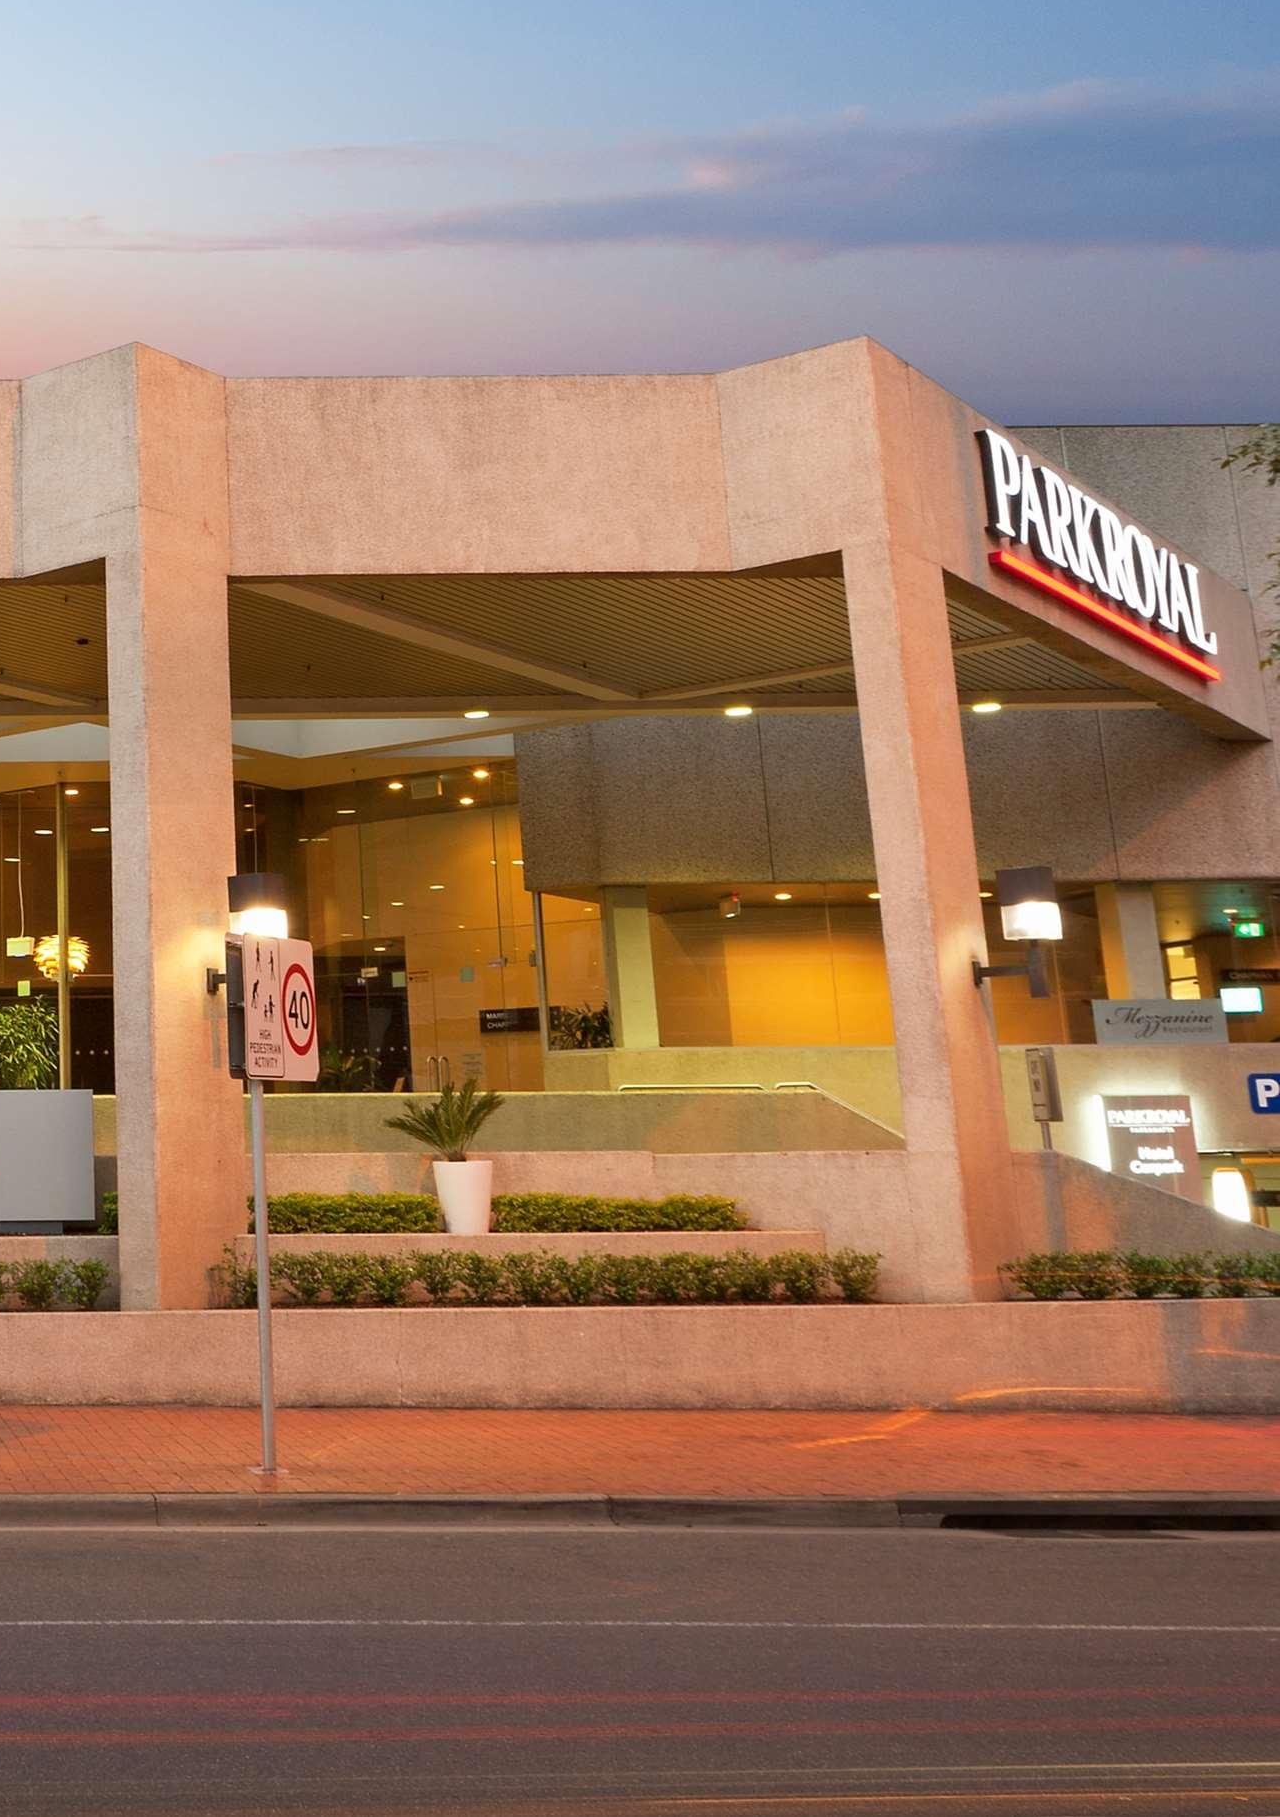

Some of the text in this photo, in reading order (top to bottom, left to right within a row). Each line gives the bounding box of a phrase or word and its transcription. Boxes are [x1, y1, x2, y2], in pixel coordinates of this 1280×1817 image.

[976, 429, 1218, 655] PARKROYAL
[289, 990, 309, 1030] 40
[1106, 1007, 1214, 1039] Mezzanine
[1255, 1079, 1280, 1108] P
